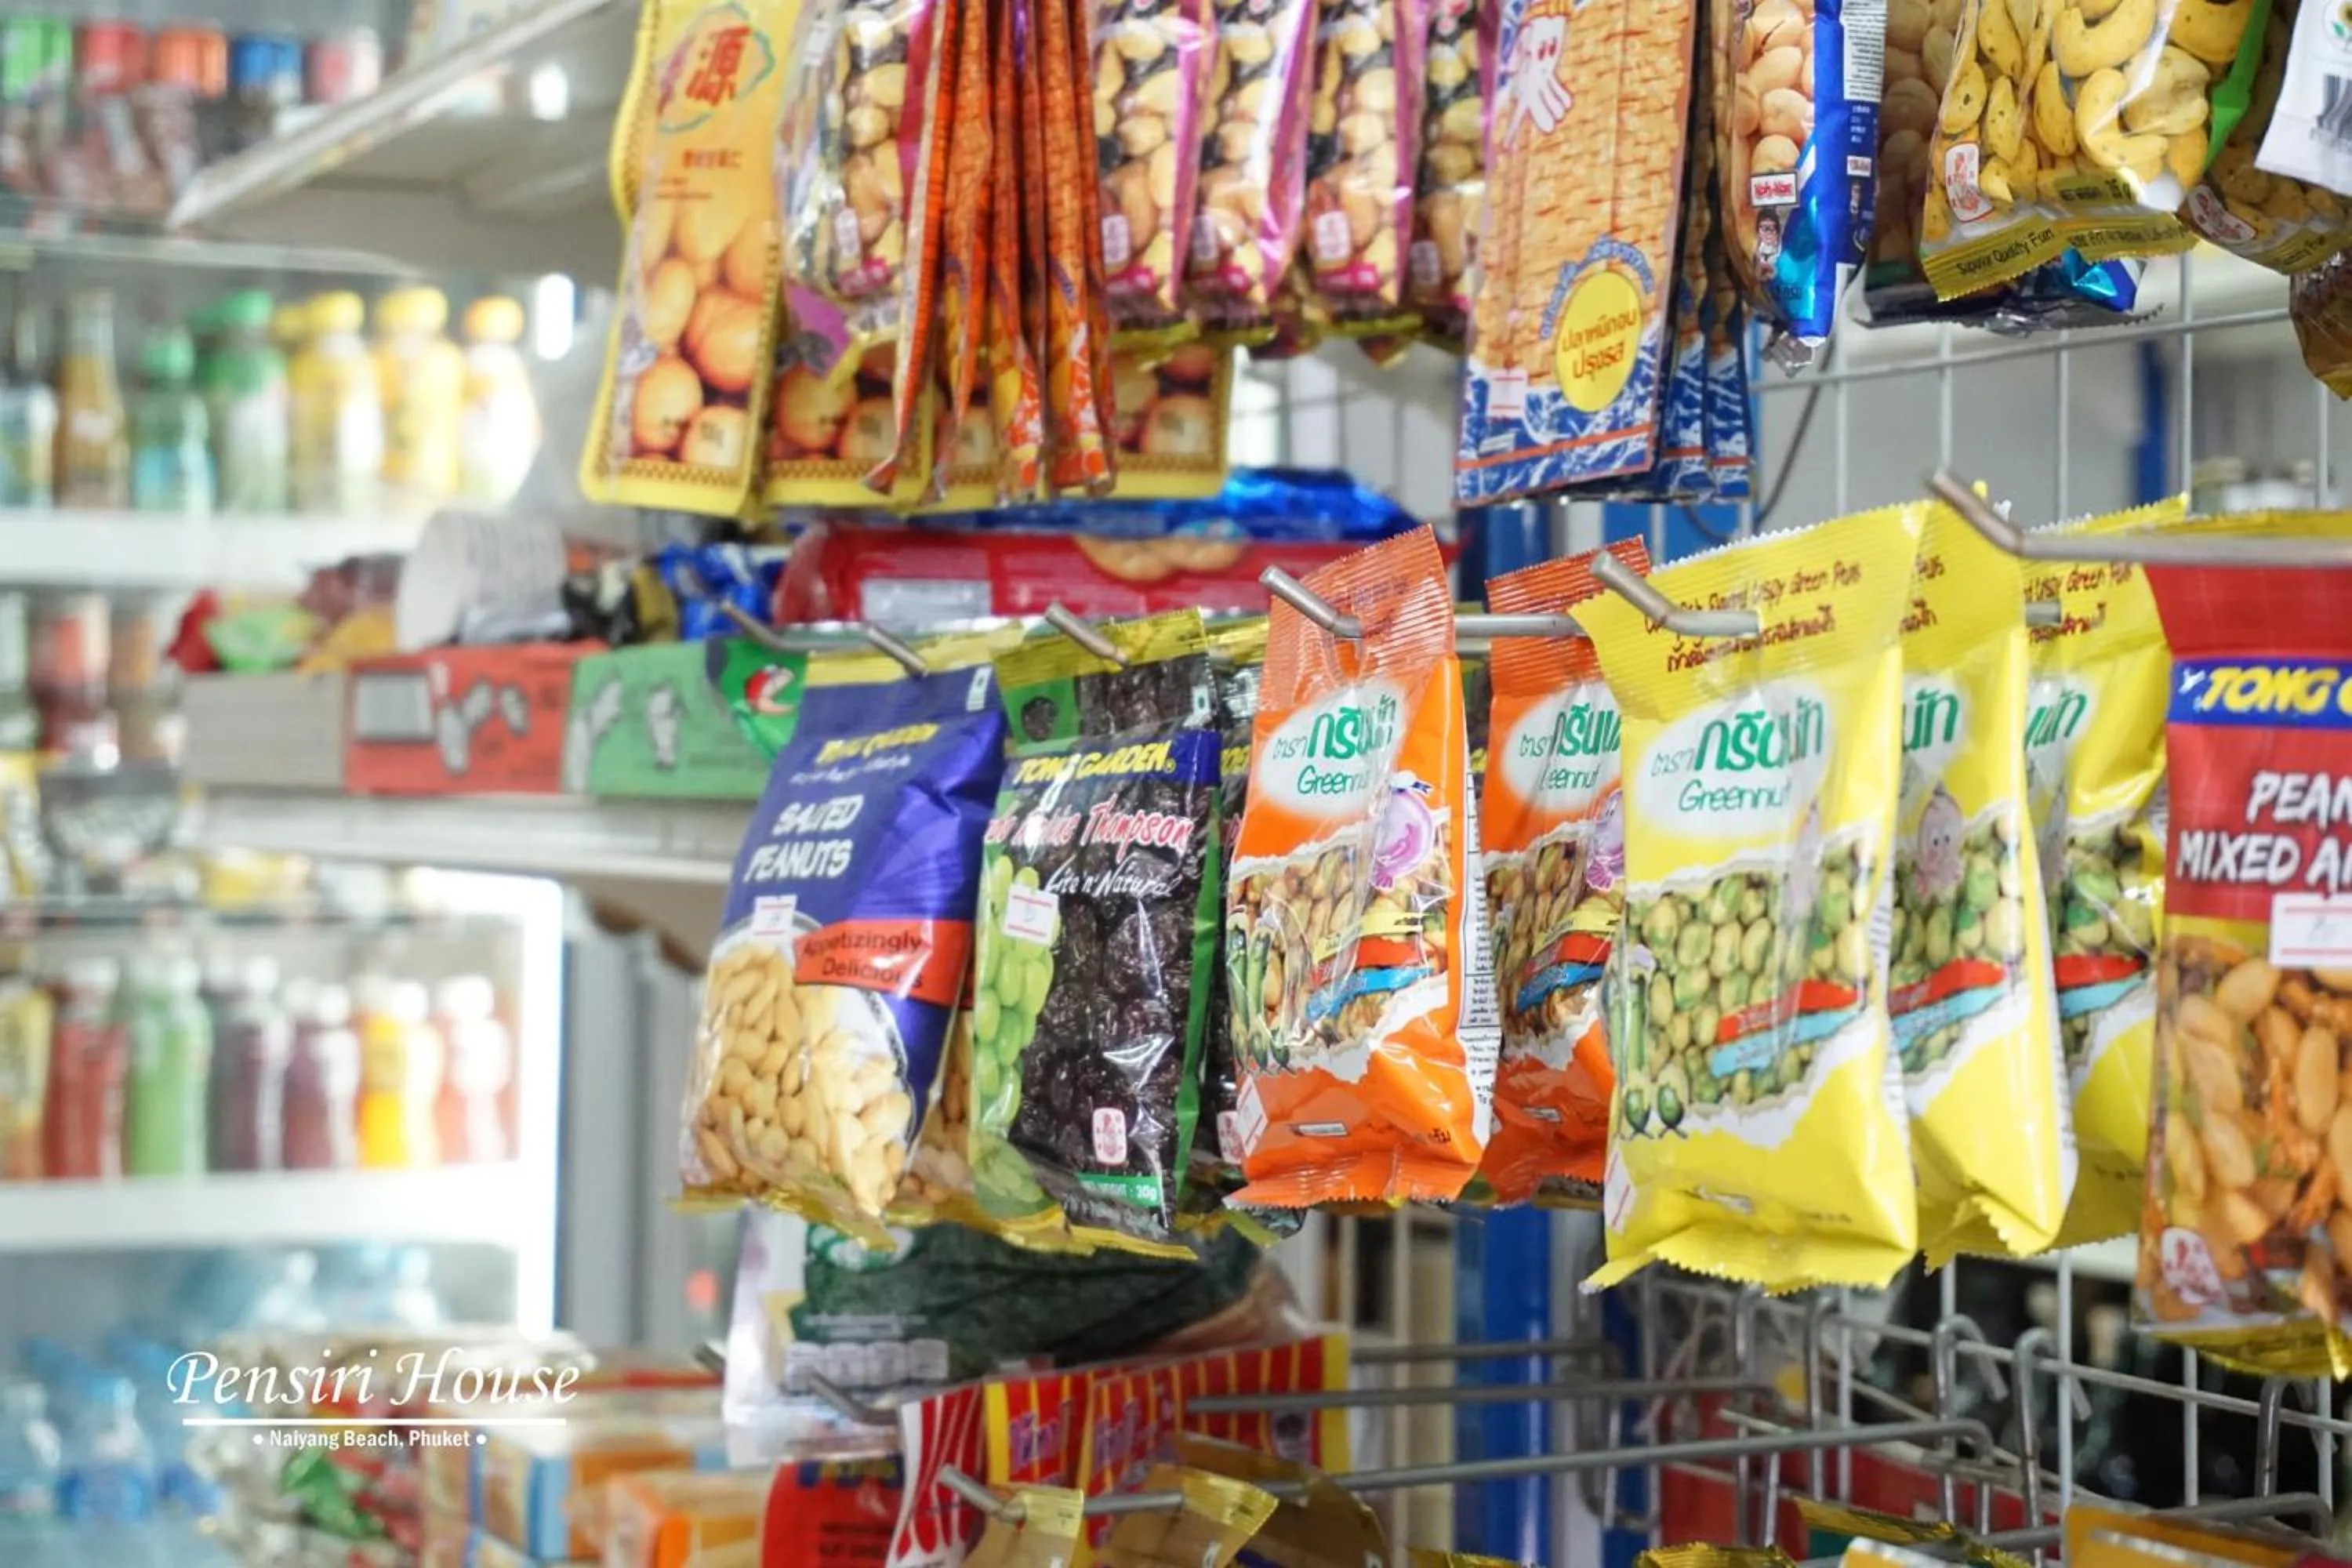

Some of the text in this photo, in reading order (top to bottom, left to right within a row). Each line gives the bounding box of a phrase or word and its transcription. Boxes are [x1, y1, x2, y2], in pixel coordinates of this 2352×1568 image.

[2194, 666, 2340, 713] TONG
[2245, 770, 2352, 831] PEAN
[2175, 828, 2301, 886] MIXED
[821, 956, 924, 989] Delicios
